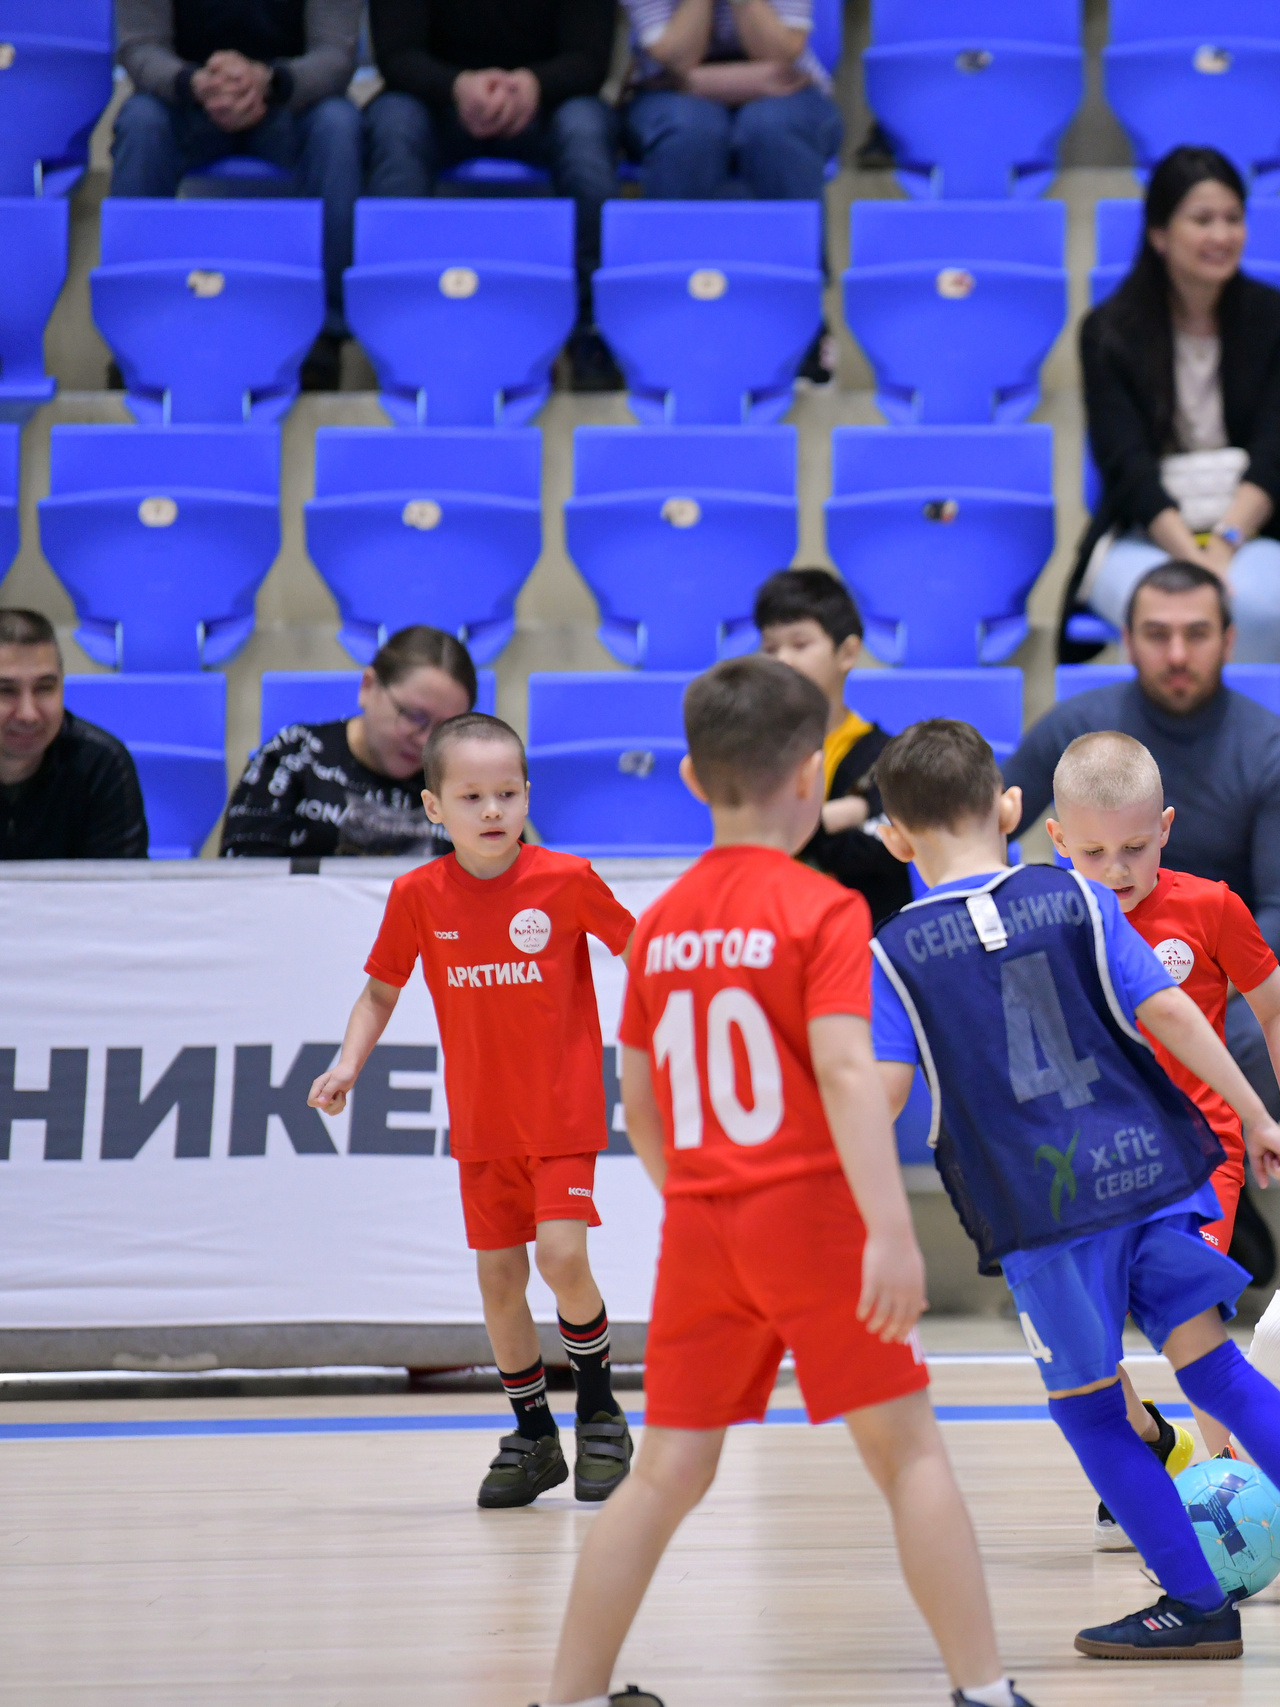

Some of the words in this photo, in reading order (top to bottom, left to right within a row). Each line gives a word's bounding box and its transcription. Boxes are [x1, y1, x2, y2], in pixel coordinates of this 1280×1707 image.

[447, 960, 543, 987] АРКТИКА
[644, 927, 775, 977] ЛЮТОВ
[1001, 950, 1100, 1109] 4
[652, 986, 784, 1150] 10
[1095, 1162, 1163, 1200] СЕВЕР
[1199, 1230, 1219, 1246] ODES
[1019, 1311, 1053, 1363] 4
